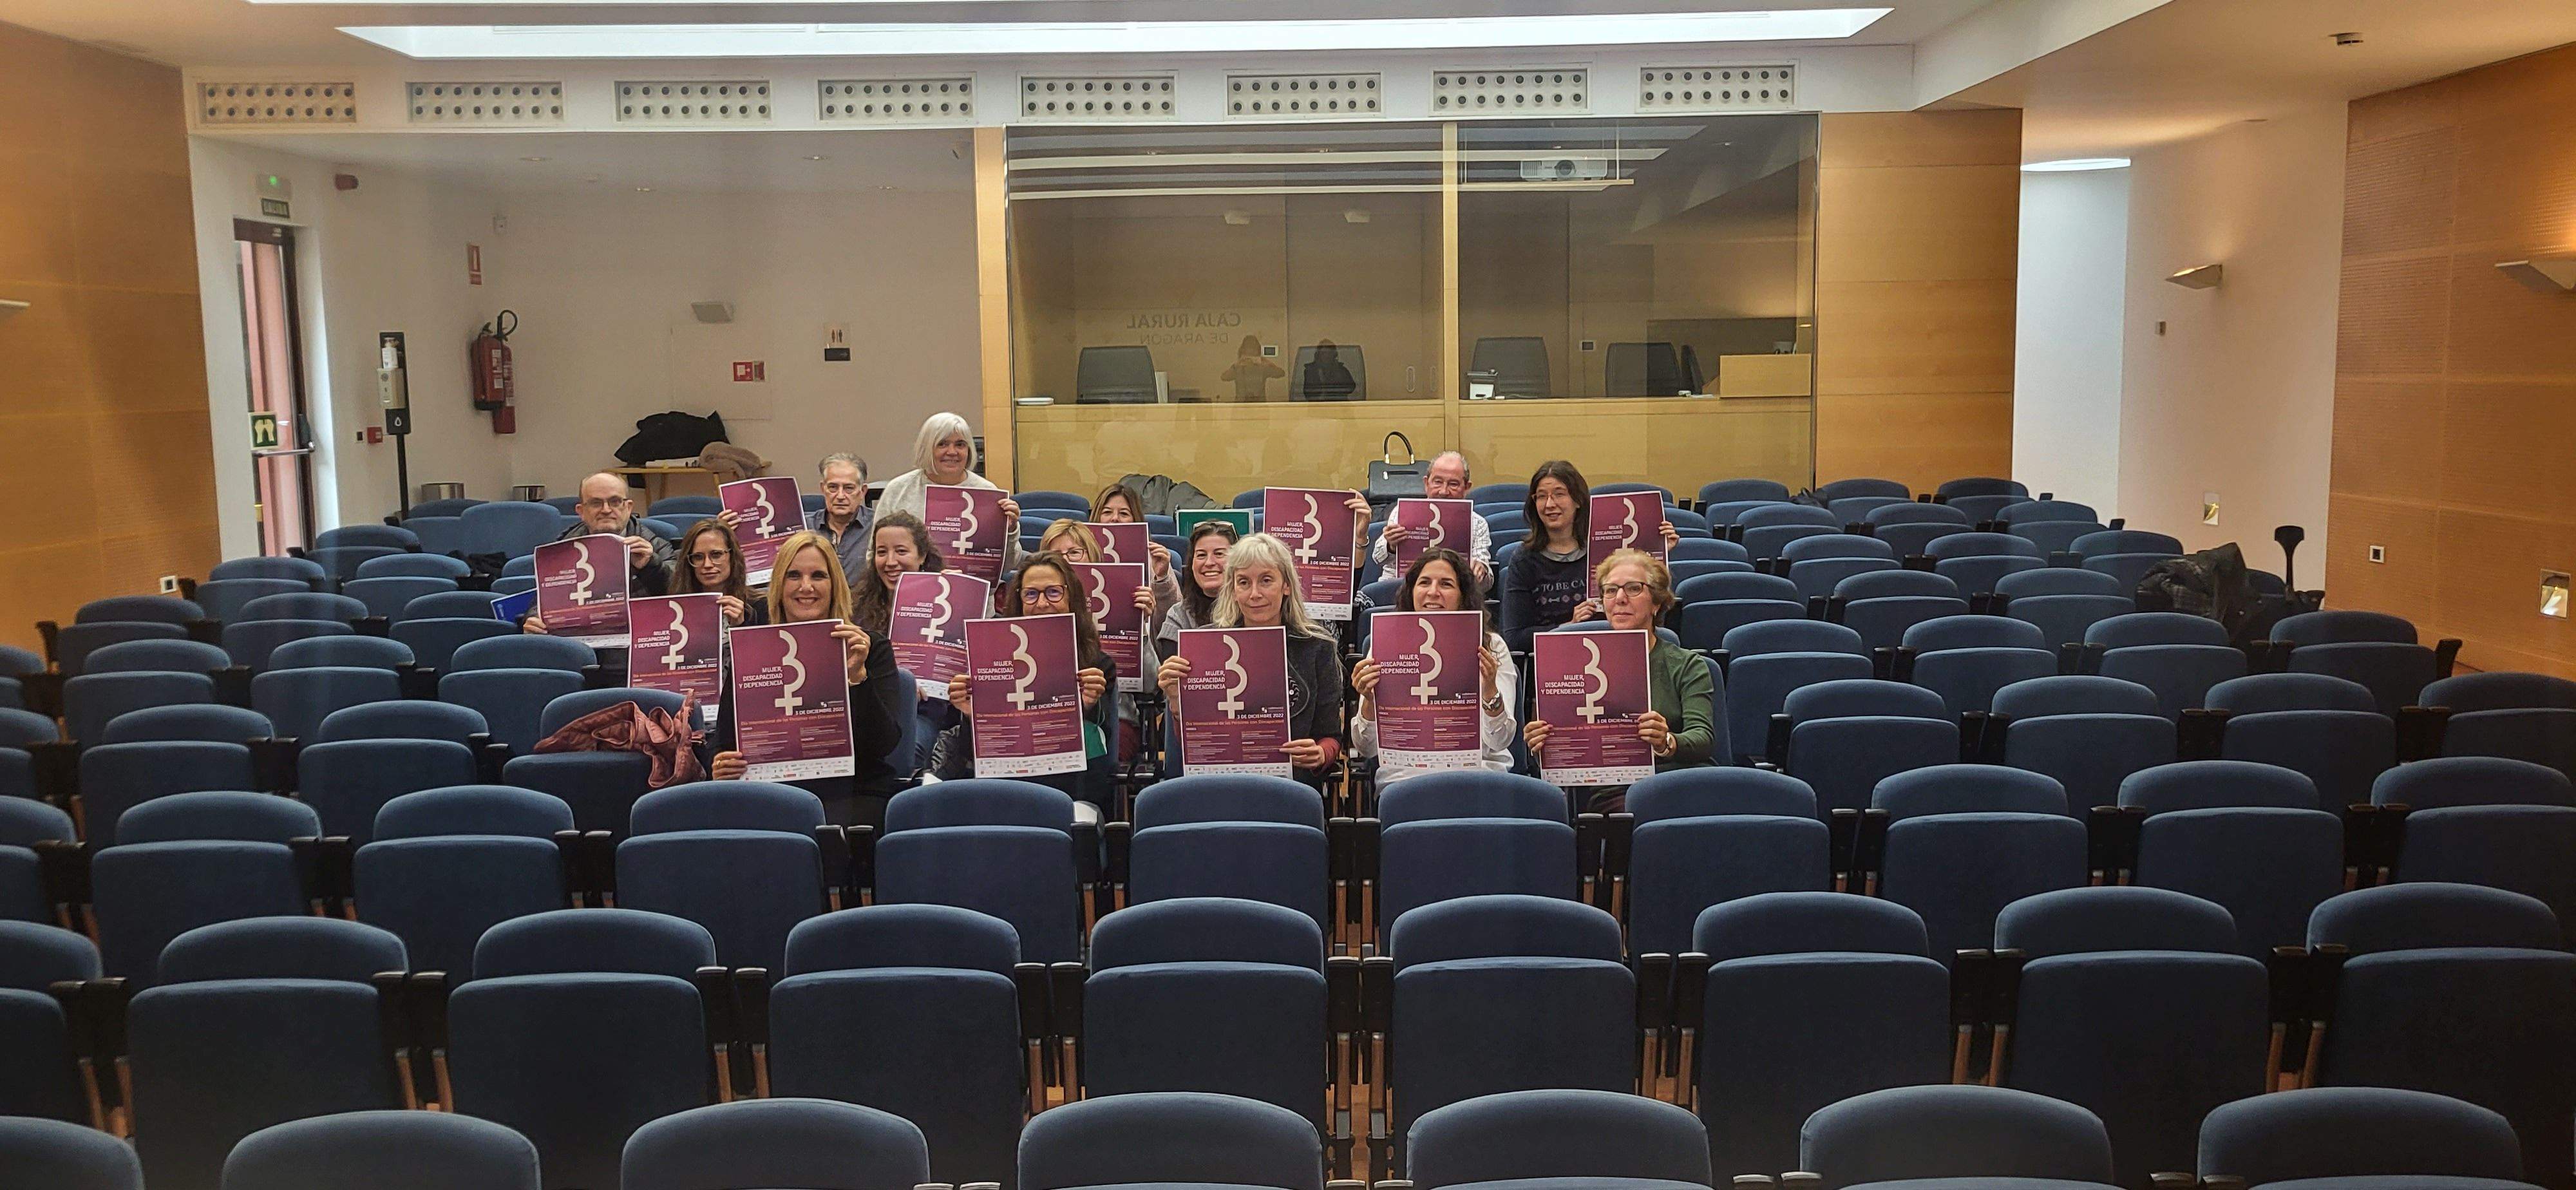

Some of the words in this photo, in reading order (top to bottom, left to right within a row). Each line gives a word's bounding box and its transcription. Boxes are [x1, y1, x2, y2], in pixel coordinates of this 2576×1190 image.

[1541, 583, 1553, 592] TO
[1556, 582, 1569, 590] BE
[743, 673, 783, 682] DISCAPACIDAD
[744, 680, 783, 688] DEPENDENCIA
